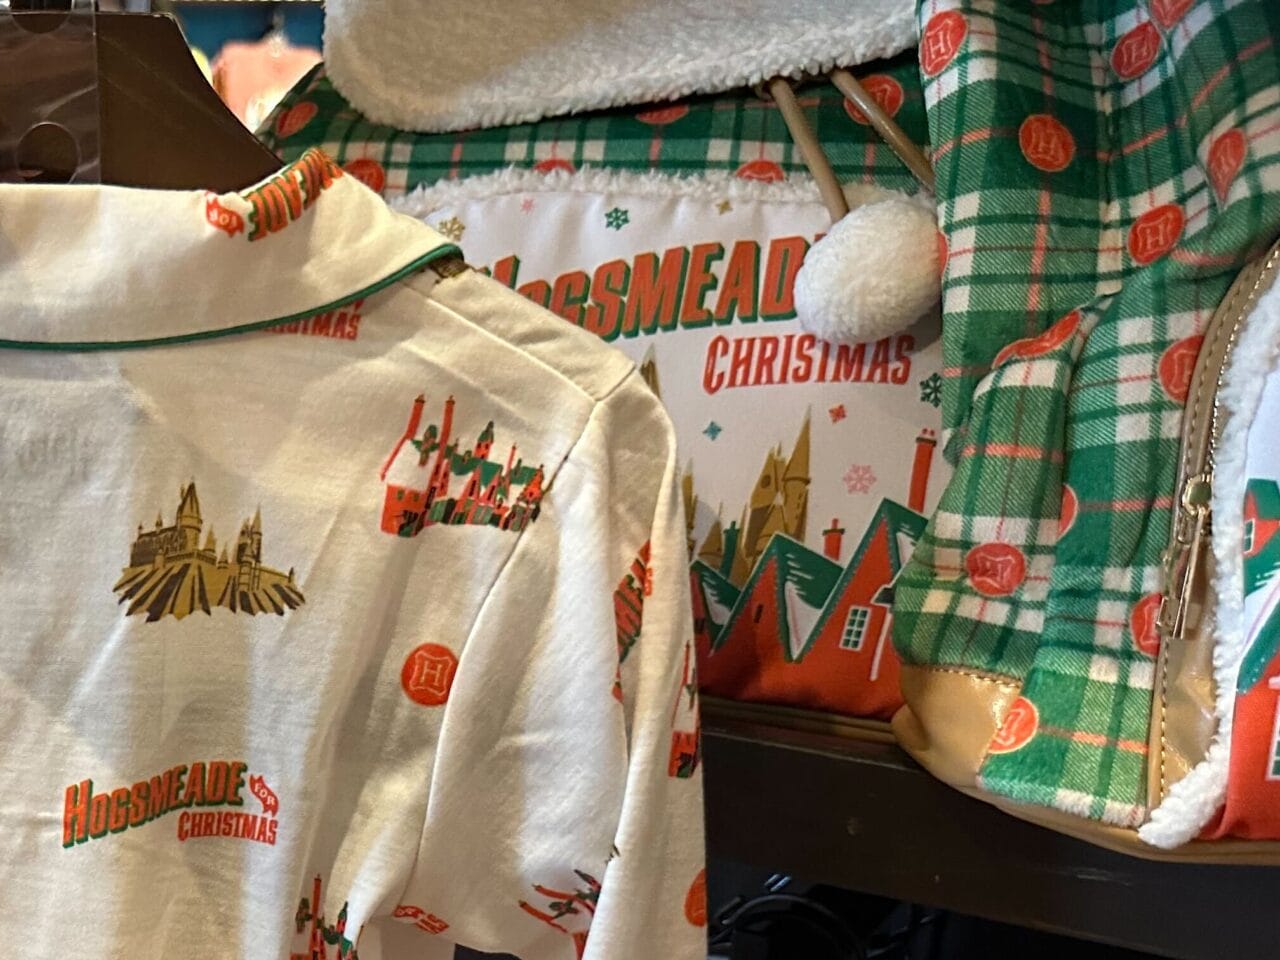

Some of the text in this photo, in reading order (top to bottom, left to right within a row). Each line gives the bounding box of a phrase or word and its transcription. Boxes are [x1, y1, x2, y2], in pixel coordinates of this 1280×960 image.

[477, 231, 826, 343] OGSMEAD
[62, 760, 248, 849] HOGSMEADE
[176, 810, 279, 847] CHRISTMAS
